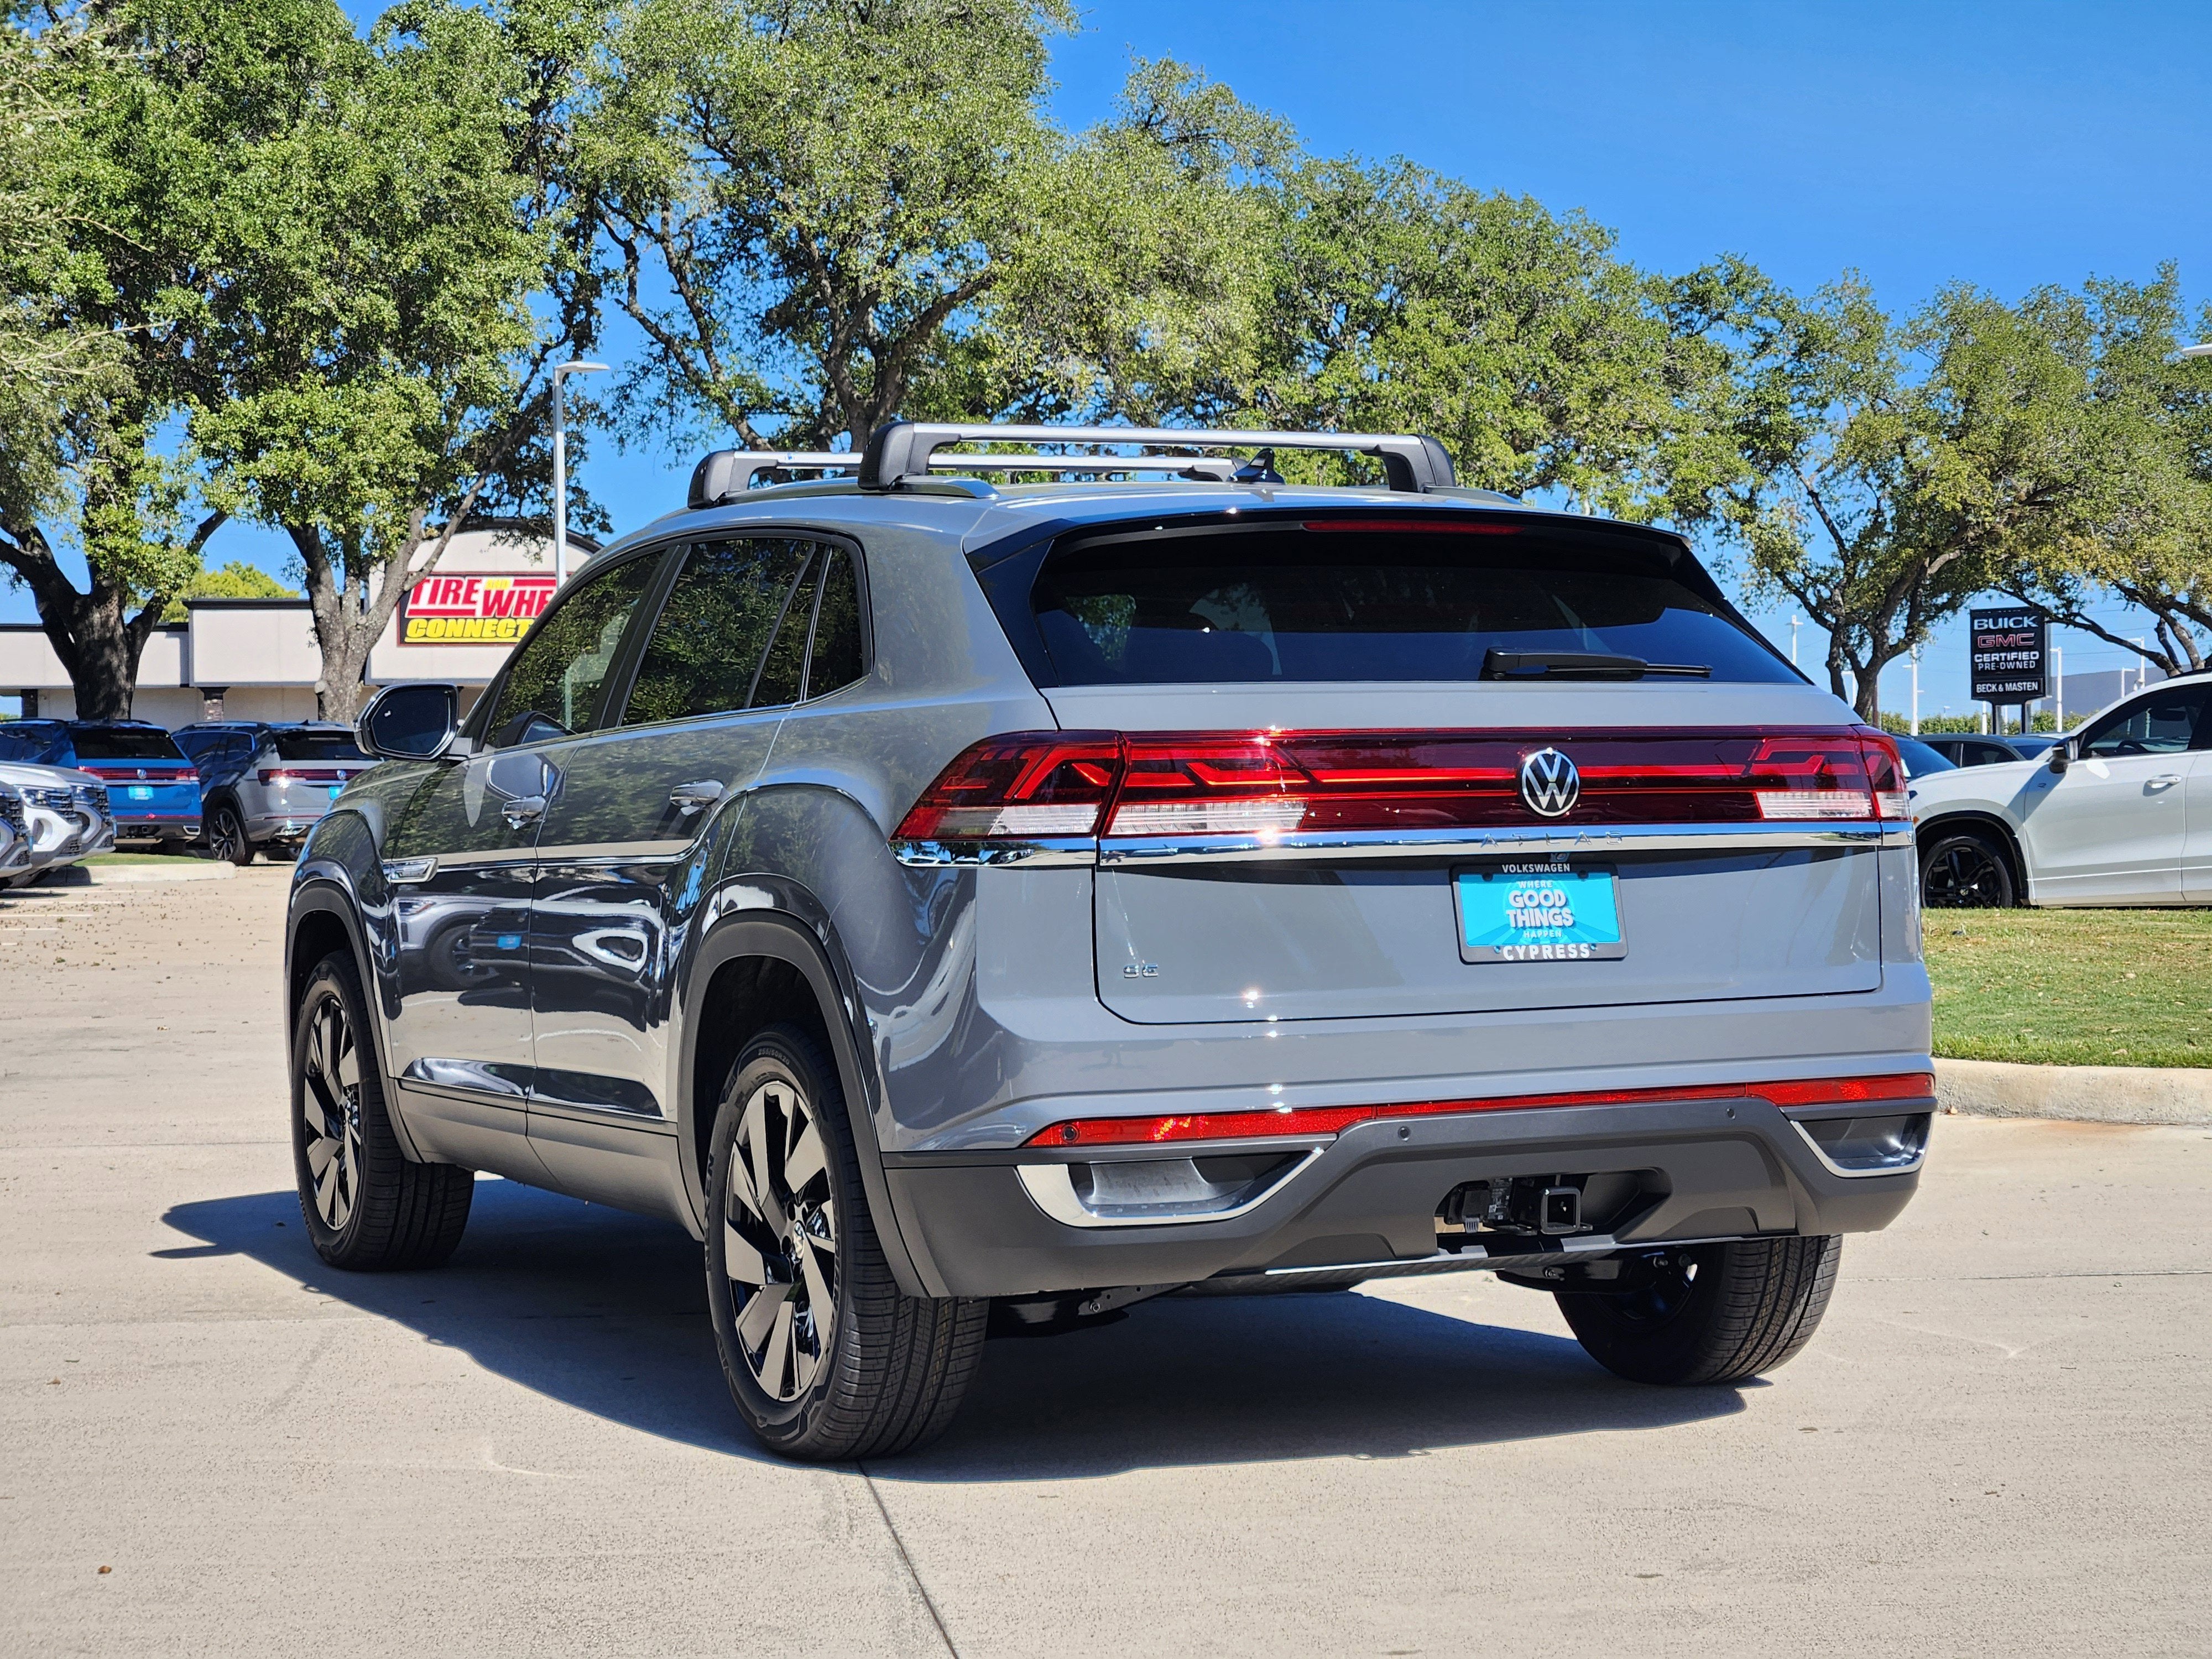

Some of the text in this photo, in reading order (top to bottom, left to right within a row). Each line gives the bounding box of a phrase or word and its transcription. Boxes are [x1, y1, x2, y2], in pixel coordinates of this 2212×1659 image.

[410, 578, 482, 605] TIRE
[485, 578, 510, 589] AND
[1974, 615, 2038, 630] BUICK
[1978, 633, 2035, 648] GMC
[1974, 651, 2039, 662] CERTIFIED
[1978, 661, 2036, 671] PRE-OWNED
[1976, 684, 1997, 693] BECK
[2005, 681, 2038, 691] MASTEN
[1480, 830, 1622, 847] ATLAS
[1501, 863, 1571, 873] VOLKSWAGEN
[1517, 880, 1553, 889] WHERE
[1508, 890, 1566, 907] GOOD
[1506, 909, 1574, 928] THINGS
[1503, 944, 1590, 960] CYPRESS
